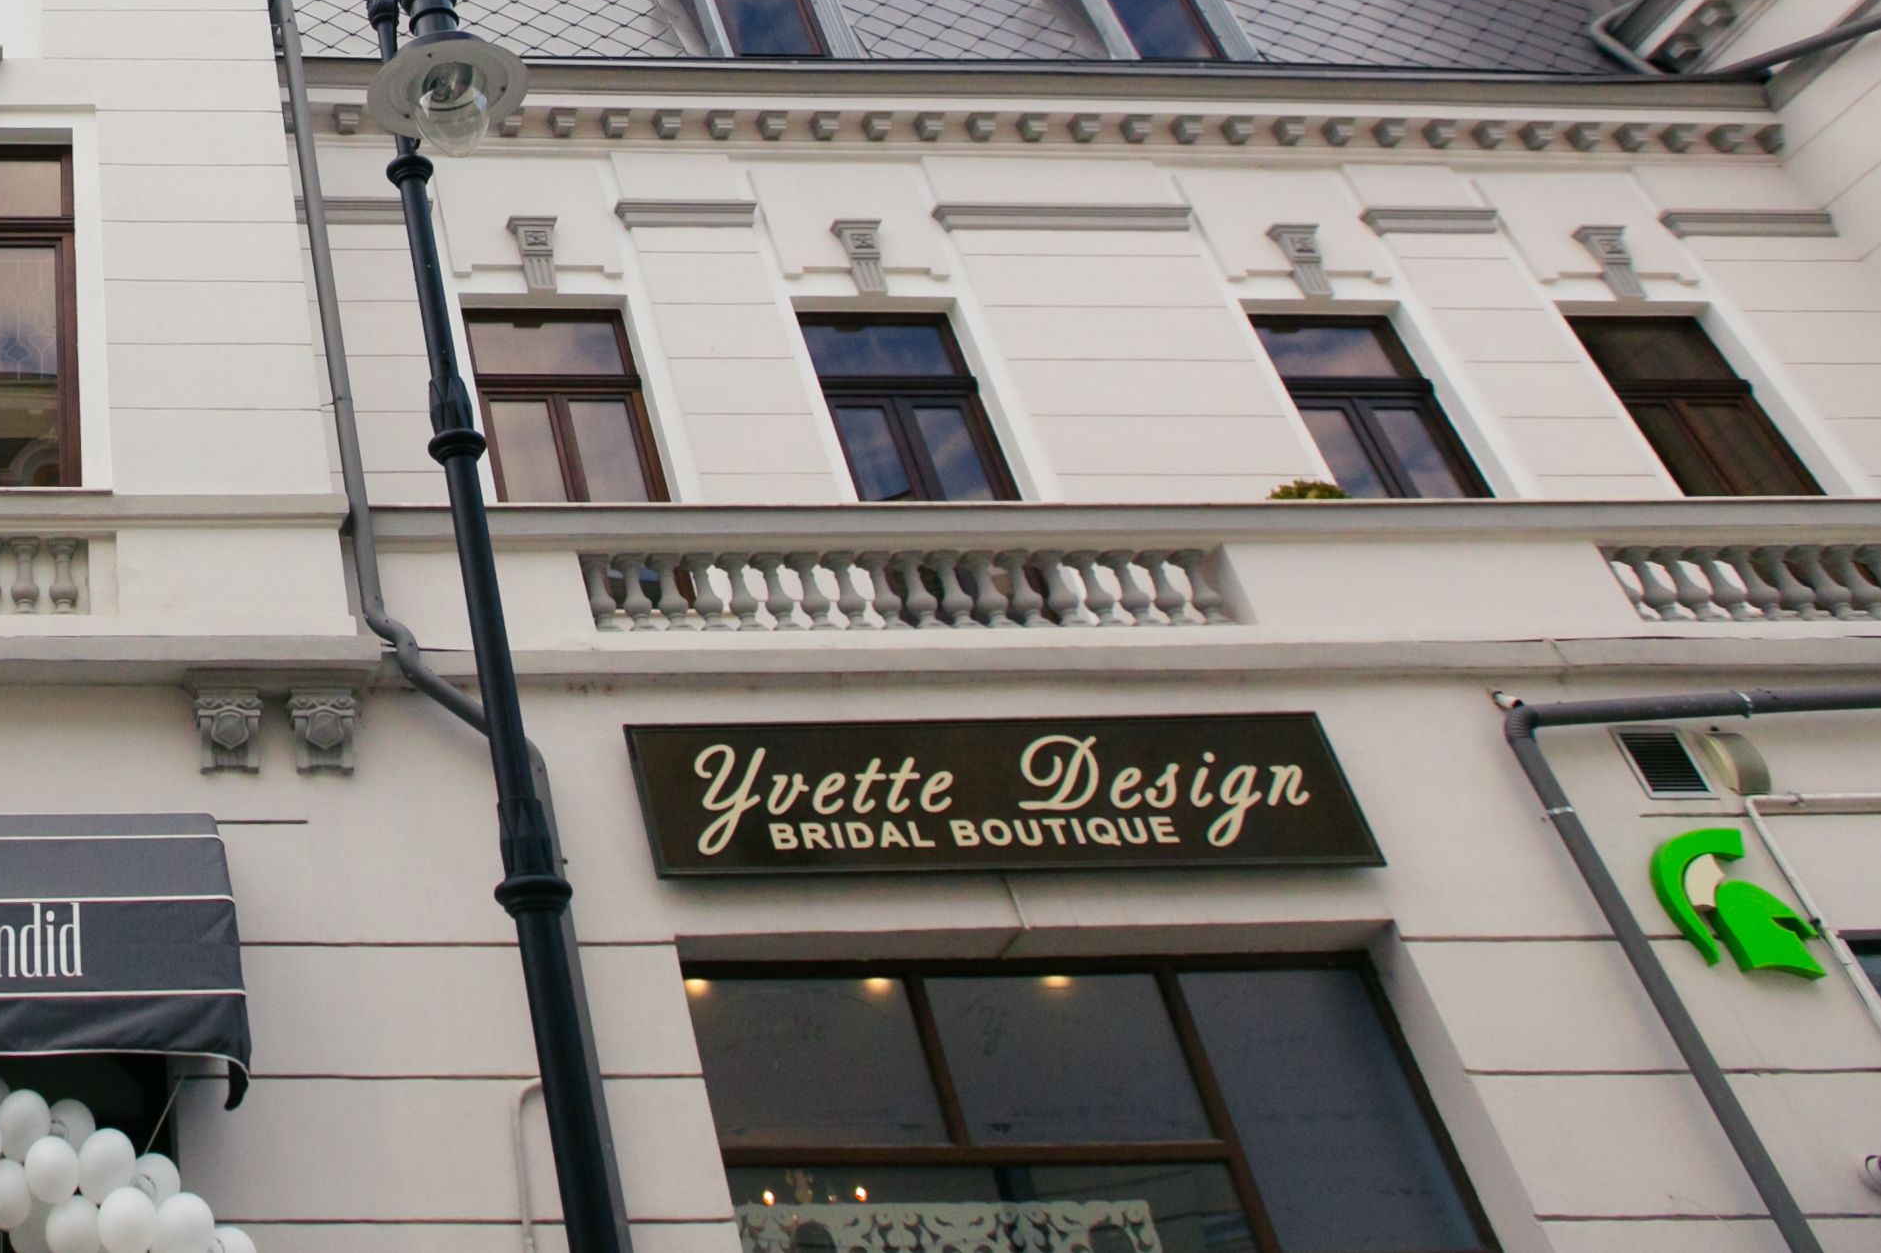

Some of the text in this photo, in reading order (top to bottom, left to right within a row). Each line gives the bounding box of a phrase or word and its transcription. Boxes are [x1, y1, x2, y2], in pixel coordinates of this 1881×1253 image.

[694, 734, 1311, 855] Yvette Design
[768, 816, 1182, 851] BRIDAL BOUTIQUE
